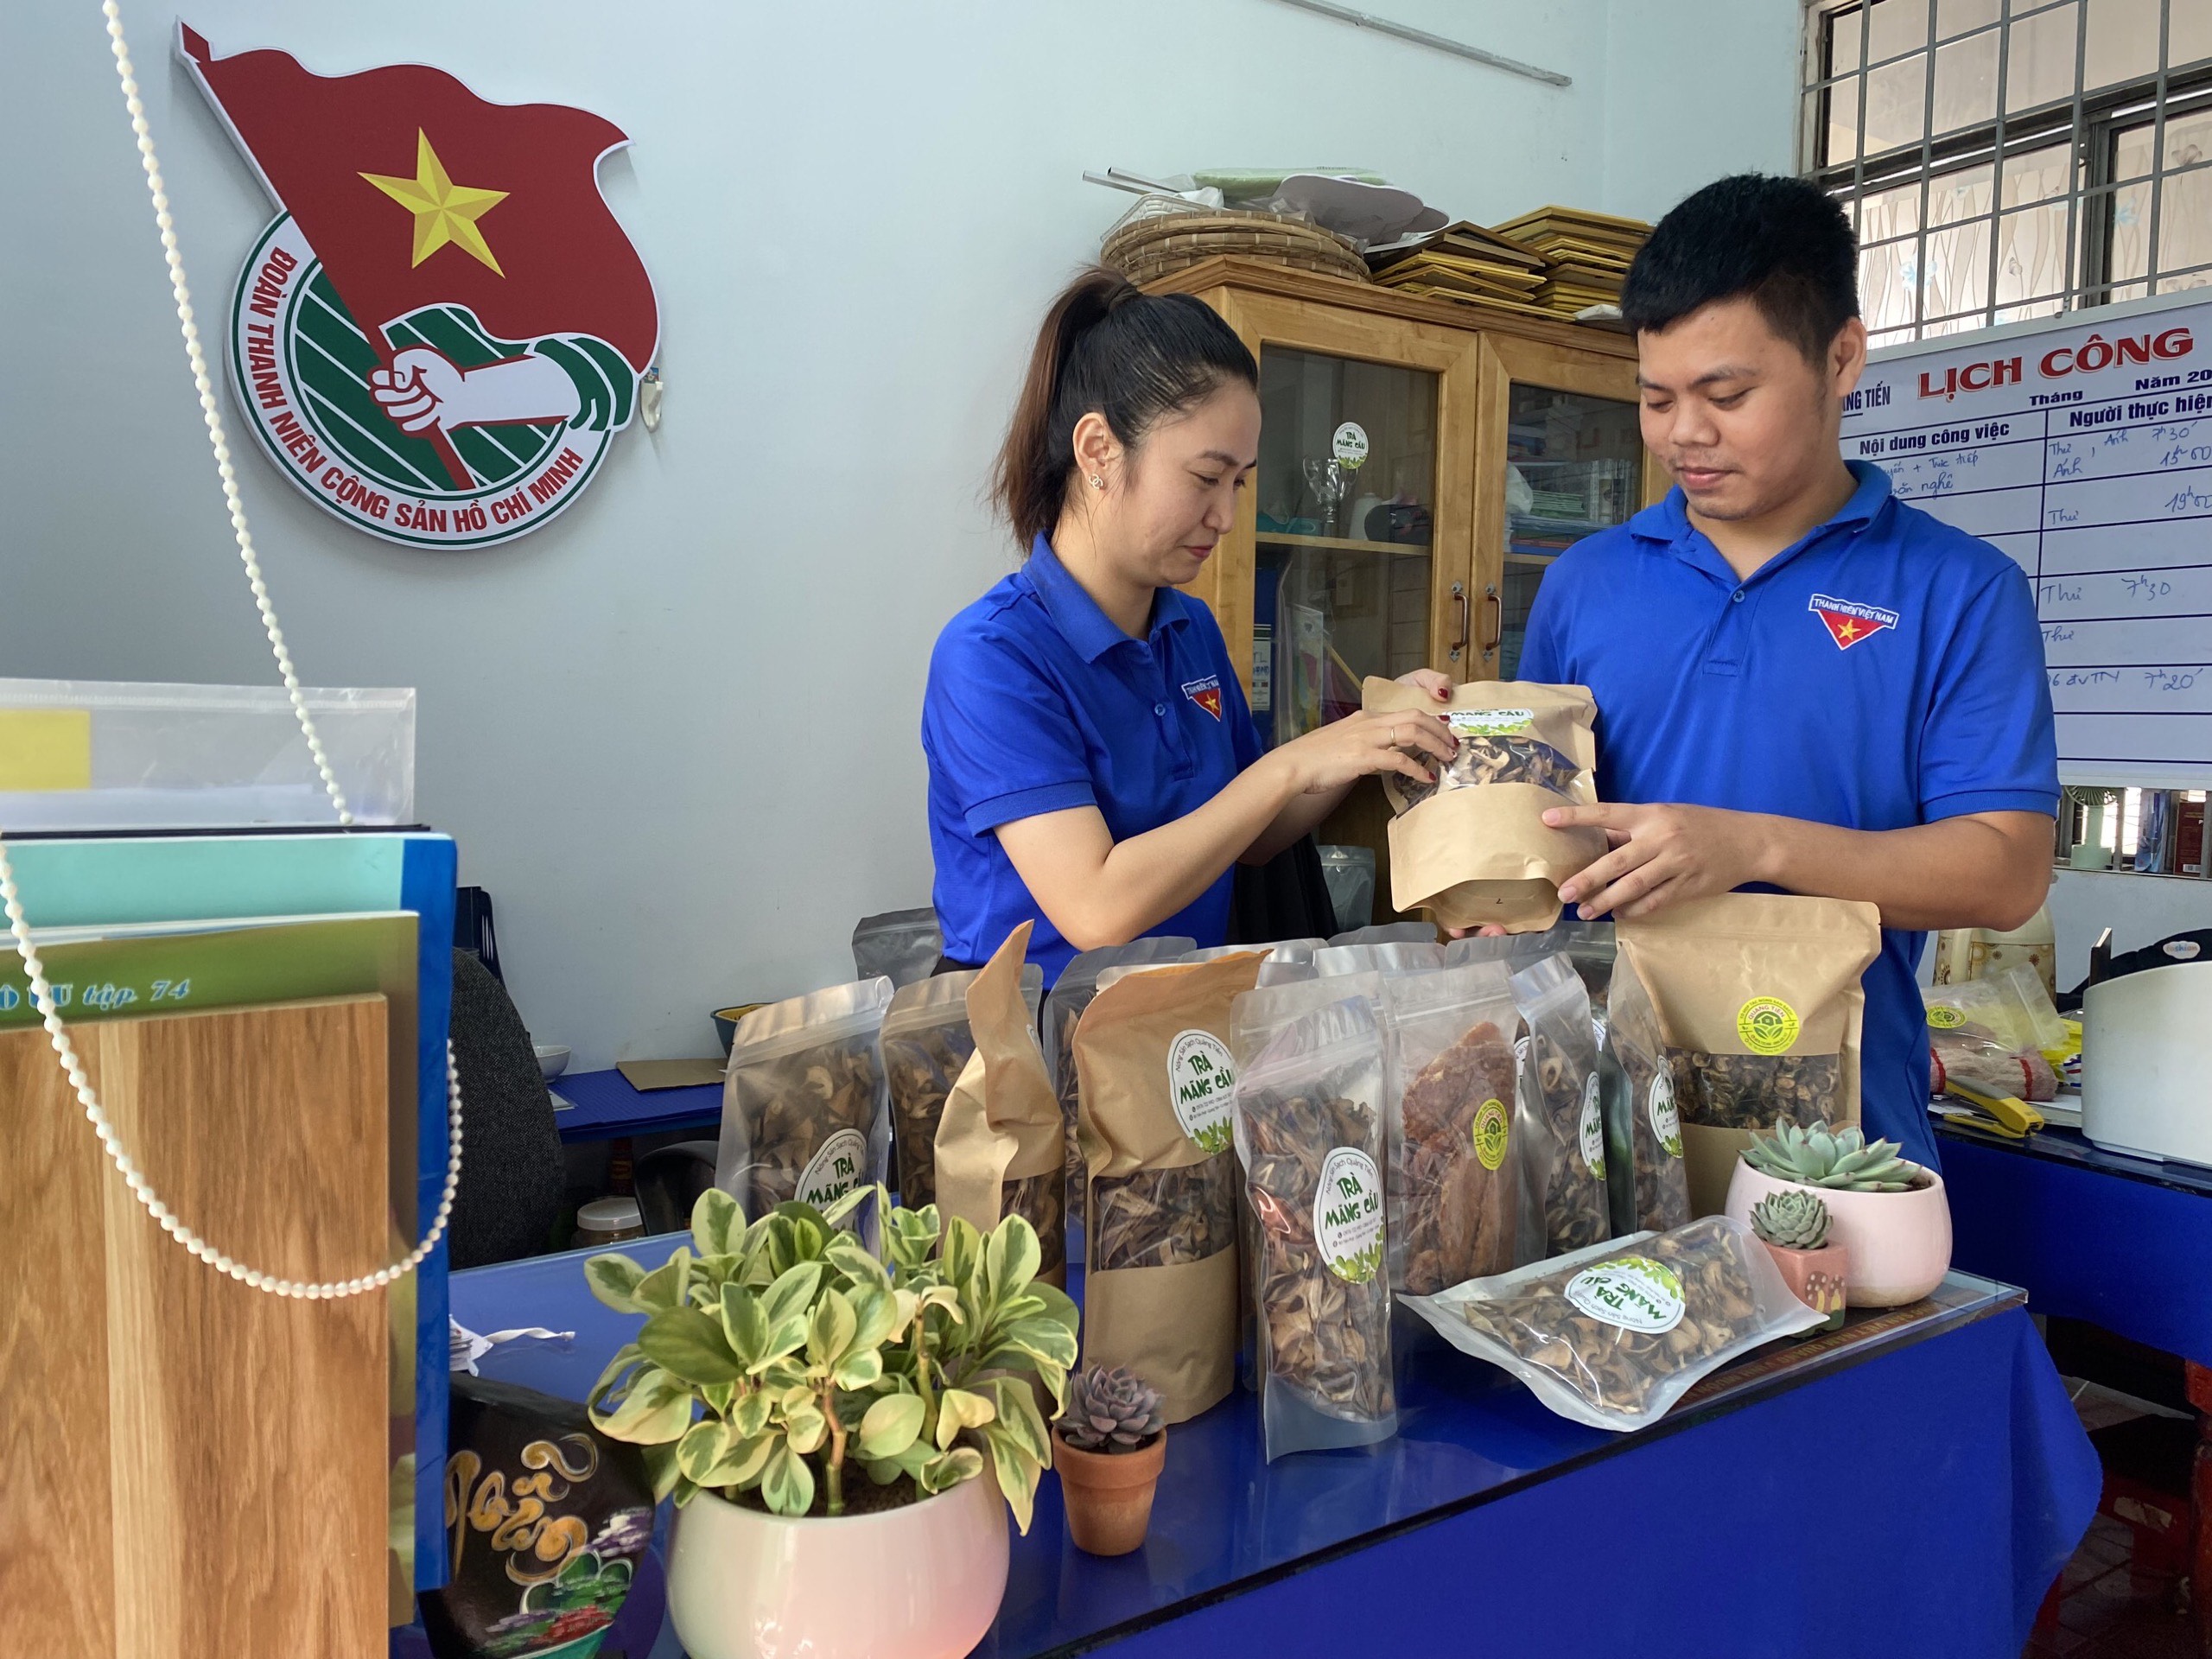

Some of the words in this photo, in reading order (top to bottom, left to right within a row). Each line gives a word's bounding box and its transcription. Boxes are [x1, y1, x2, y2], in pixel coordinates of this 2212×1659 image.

[249, 245, 298, 319] ĐOÀN
[247, 322, 289, 410] THANH
[1916, 356, 2023, 403] LỊCH
[2038, 327, 2194, 379] CÔNG
[1843, 391, 1862, 412] NG
[1866, 380, 1891, 409] TIẾN
[2029, 390, 2084, 407] Tháng
[2135, 374, 2181, 391] Năm
[2069, 409, 2122, 428] Người
[2128, 401, 2170, 421] thực
[269, 410, 327, 474] NIÊN
[1859, 438, 1885, 457] Nội
[1889, 435, 1927, 450] dung
[1931, 429, 1970, 446] công
[1975, 422, 2011, 442] việc
[527, 446, 584, 505] MINH
[320, 467, 391, 520] CỘNG
[490, 485, 533, 525] CHÍ
[394, 499, 448, 533] SẢN
[452, 498, 488, 533] HỒ
[1814, 598, 1840, 612] THANH
[1874, 612, 1894, 624] NAM
[82, 983, 138, 1011] tập
[149, 979, 190, 1002] 74
[1187, 1050, 1214, 1077] TRÀ
[1179, 1077, 1213, 1105] MÃNG
[832, 1152, 855, 1179] TRÀ
[1336, 1172, 1363, 1200] TRÀ
[1325, 1201, 1361, 1230] MÃNG
[1363, 1188, 1379, 1215] CẦU
[1593, 1286, 1624, 1311] TRÀ
[1615, 1282, 1668, 1320] MÃNG
